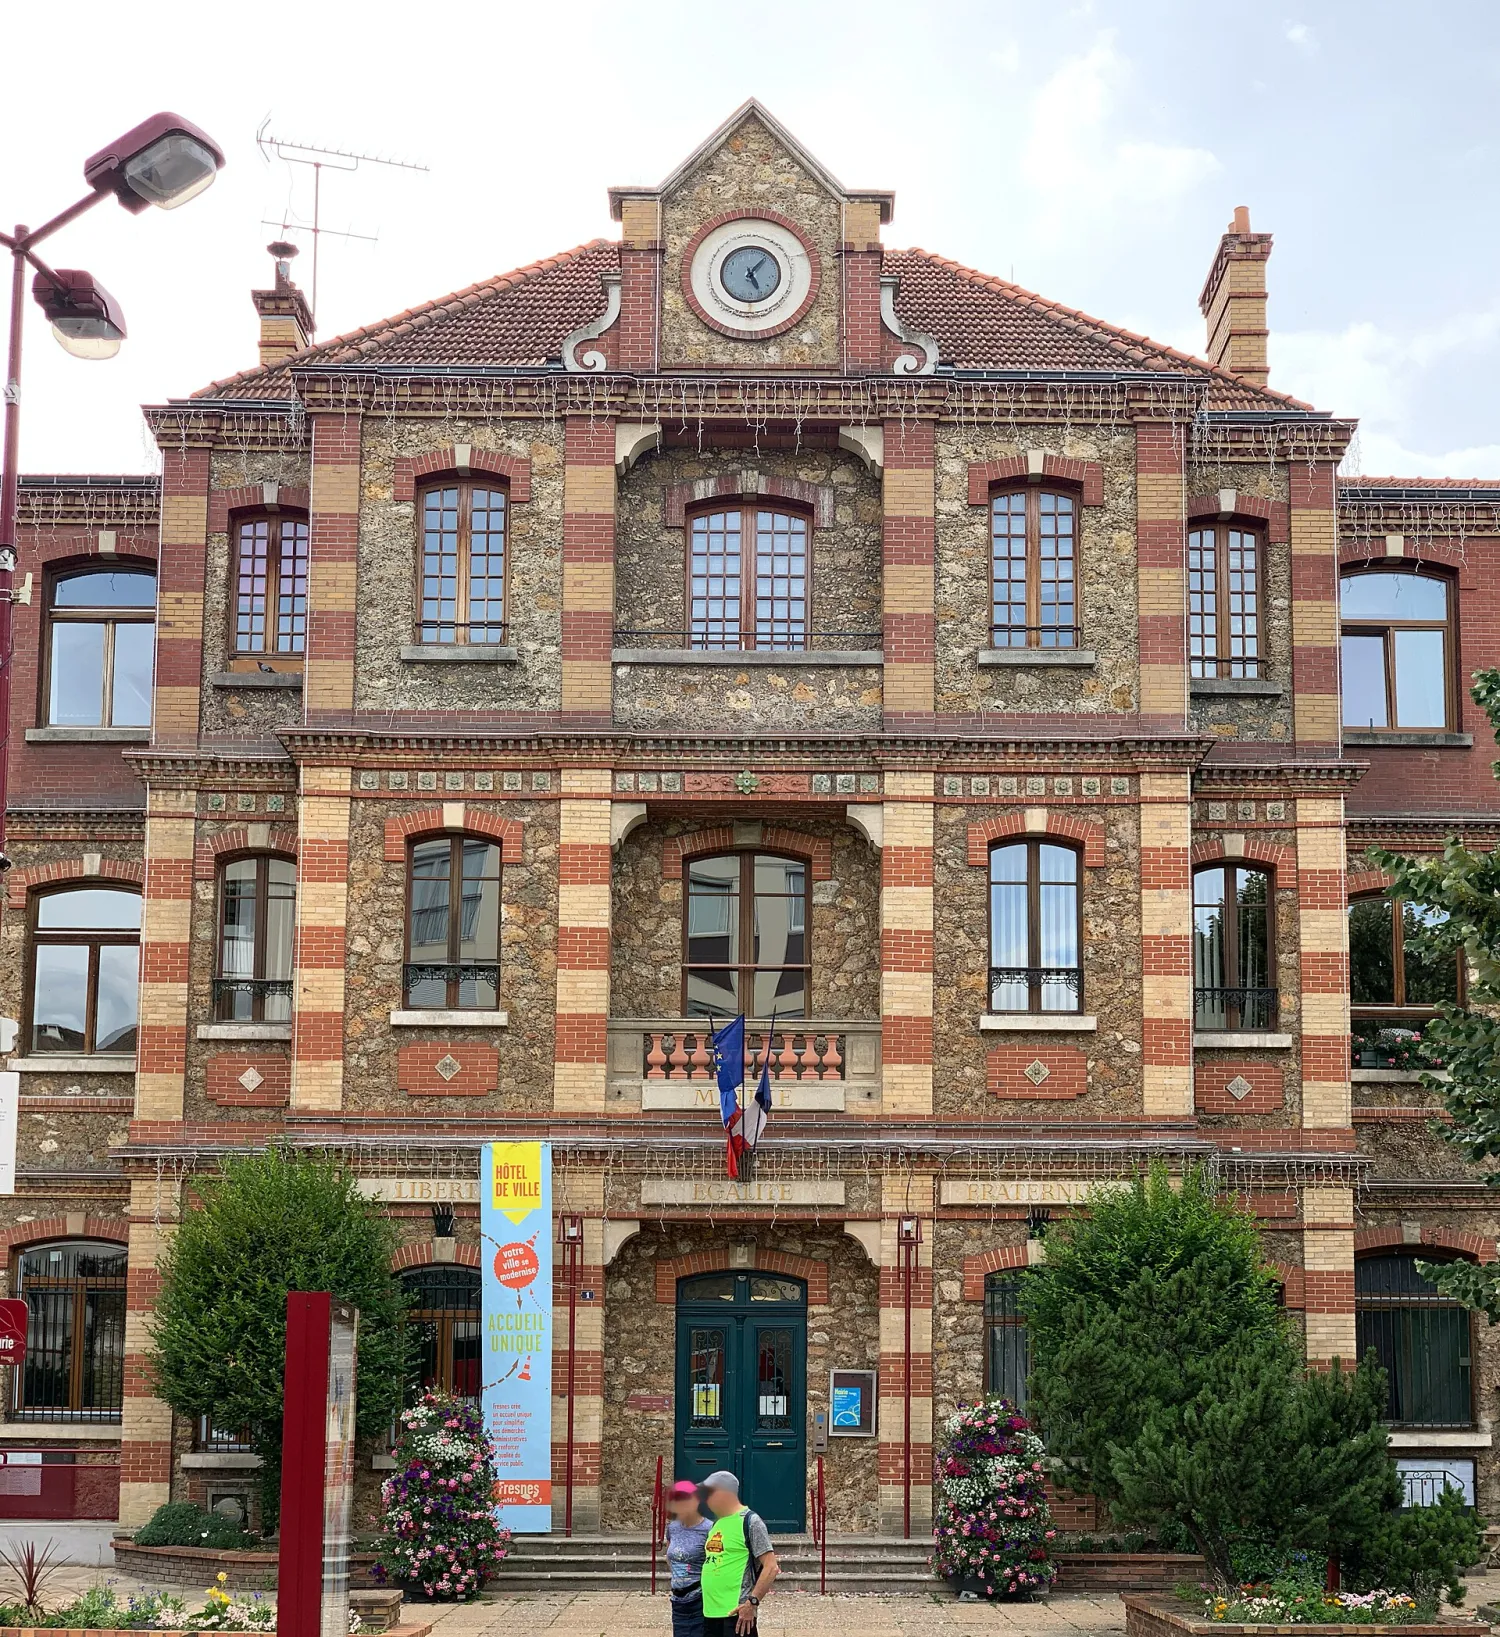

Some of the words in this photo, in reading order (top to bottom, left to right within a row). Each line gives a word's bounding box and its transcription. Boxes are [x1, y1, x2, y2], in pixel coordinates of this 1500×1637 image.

[495, 1162, 527, 1180] HÔTEL
[495, 1182, 508, 1197] DE
[512, 1182, 540, 1197] VILLE
[692, 1183, 793, 1201] EGALITE
[502, 1247, 525, 1259] votre
[502, 1258, 520, 1270] ville
[499, 1266, 537, 1282] modernise
[488, 1313, 545, 1331] ACCUEIL
[491, 1334, 543, 1355] UNIQUE
[516, 1411, 532, 1419] unique
[498, 1481, 540, 1495] Fresnes
